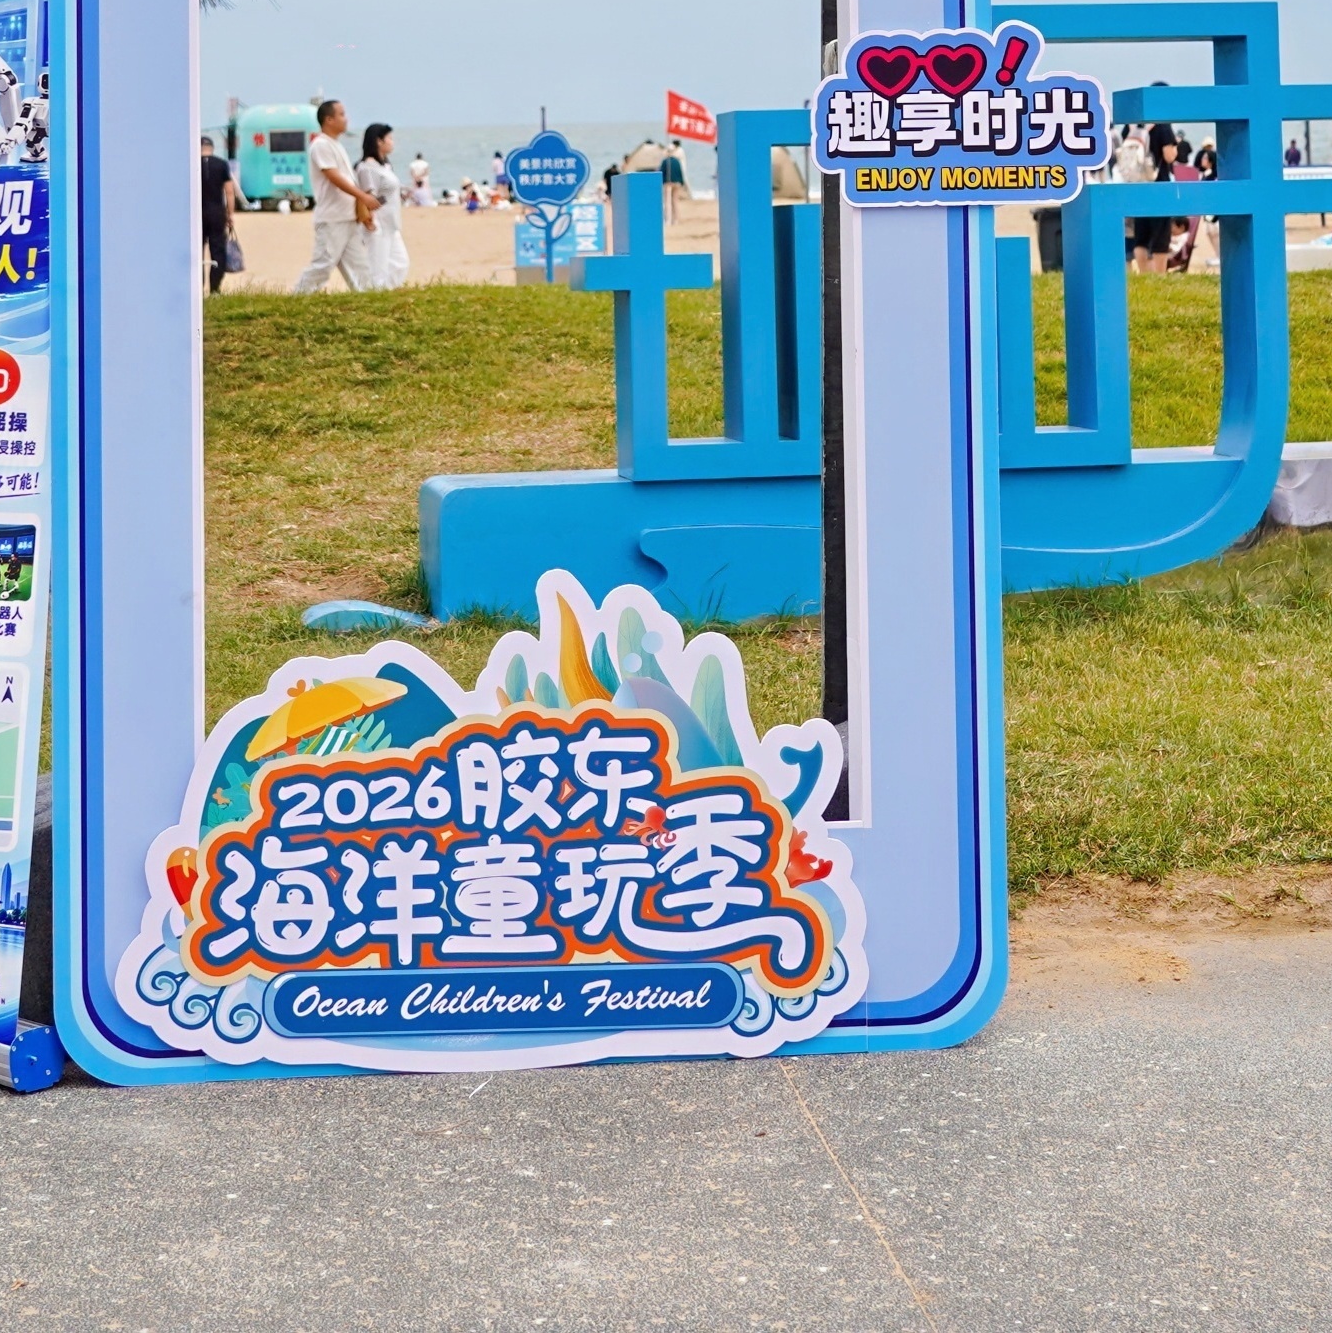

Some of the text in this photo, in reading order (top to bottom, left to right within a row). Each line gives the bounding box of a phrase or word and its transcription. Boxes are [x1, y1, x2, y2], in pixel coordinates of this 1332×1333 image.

[827, 88, 1095, 157] 趣享时光
[518, 173, 577, 186] 秩序靠大家
[856, 165, 1068, 191] ENJOY MOMENTS
[6, 676, 14, 685] N
[278, 726, 657, 833] 2026胶东
[207, 792, 805, 969] 海洋童玩季
[291, 978, 713, 1021] Ocean Children's Festival
